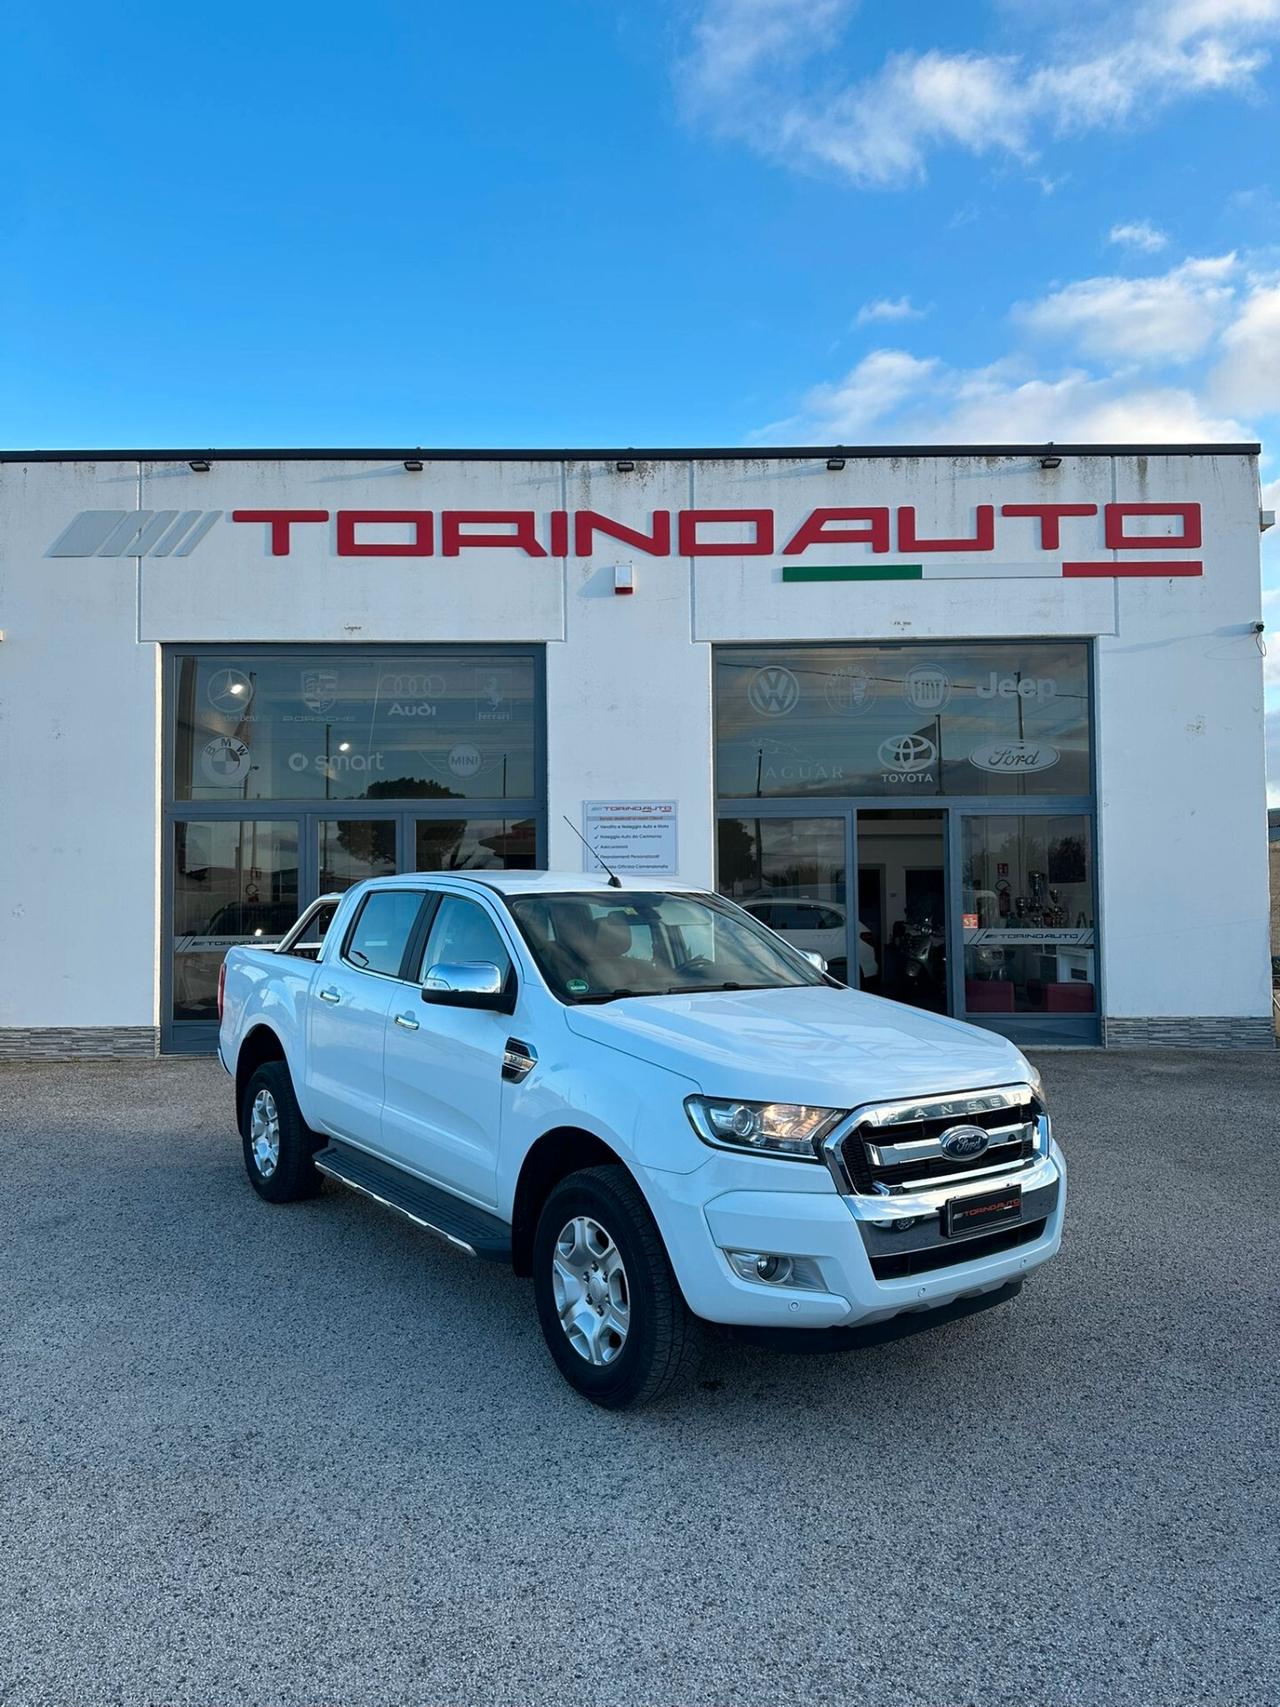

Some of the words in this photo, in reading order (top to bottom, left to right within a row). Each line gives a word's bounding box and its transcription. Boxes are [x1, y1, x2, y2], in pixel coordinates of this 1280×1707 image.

[232, 502, 1203, 558] TORINOAUTO
[976, 672, 1057, 702] Jeep
[387, 702, 437, 716] Audi
[203, 738, 249, 758] BMW
[987, 745, 1041, 767] Ford
[314, 752, 385, 771] smart
[451, 755, 479, 766] MINI
[881, 773, 934, 784] TOYOTA
[956, 1134, 984, 1153] Ford
[965, 1199, 1022, 1217] TORINOAUTO
